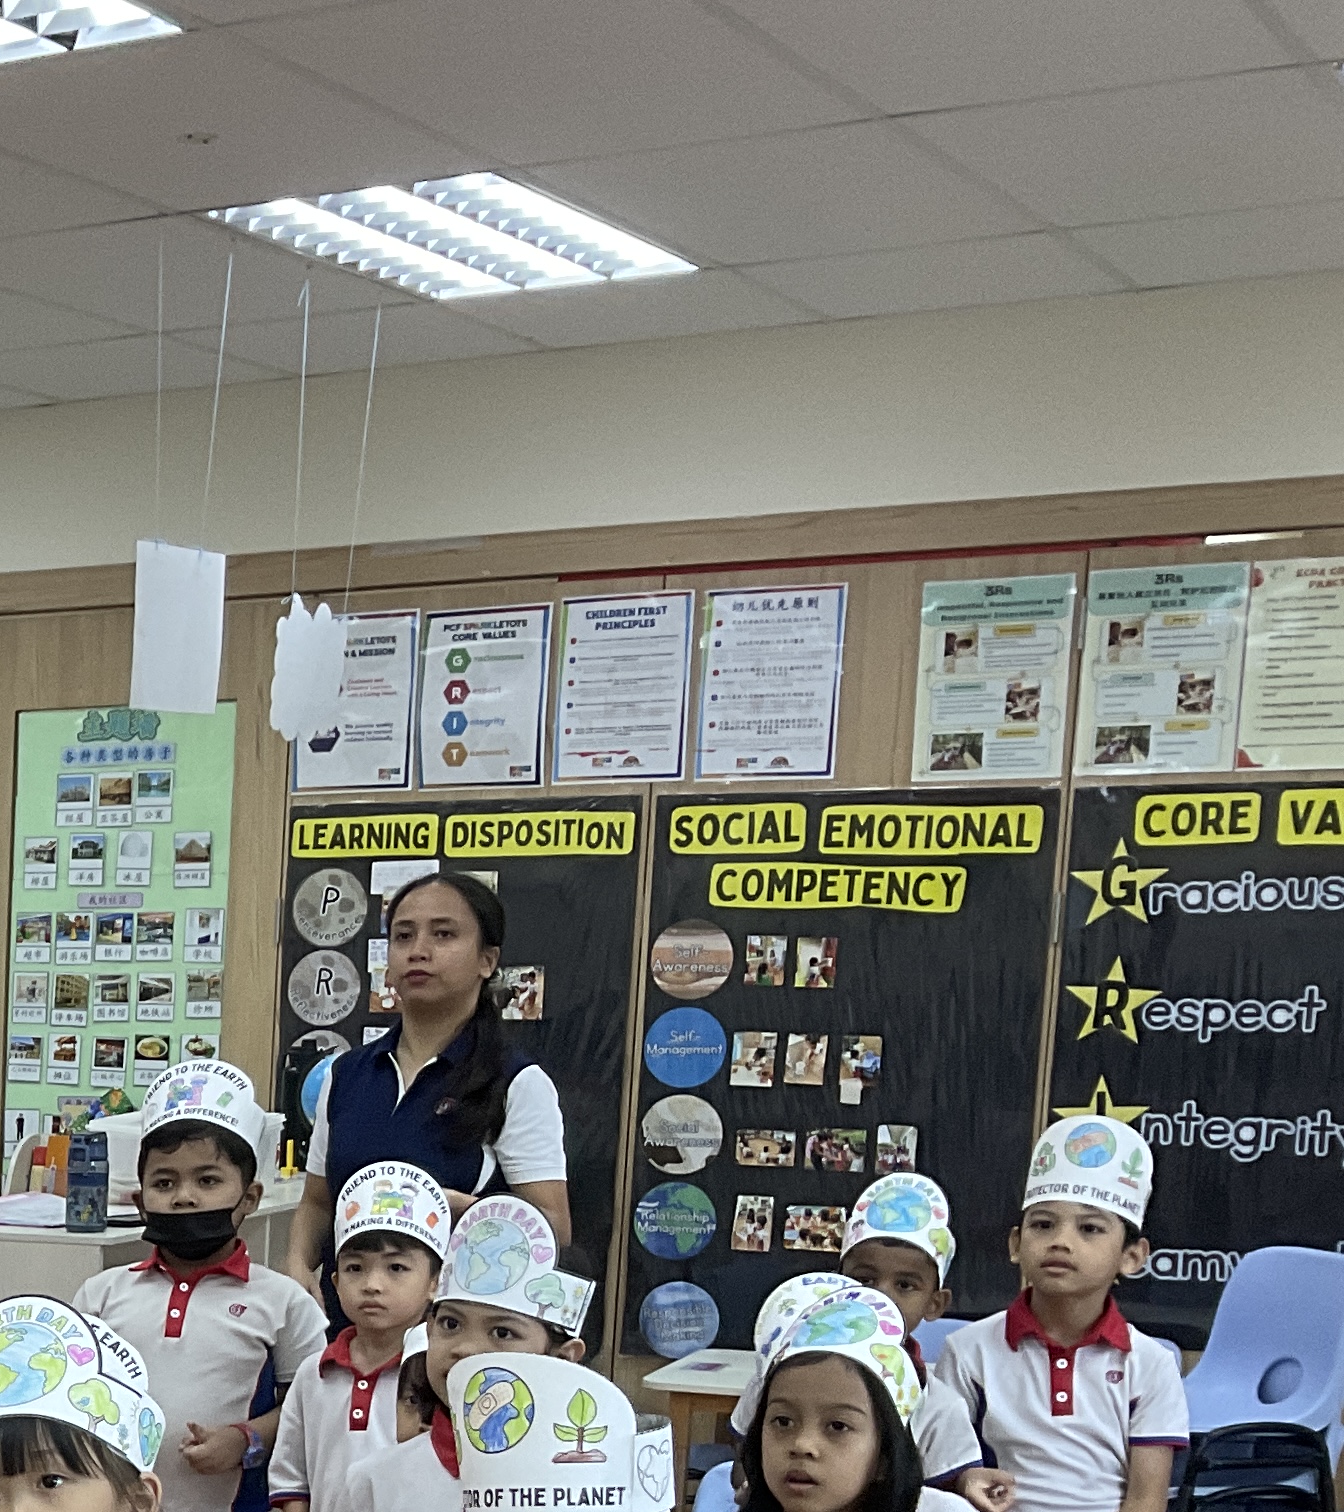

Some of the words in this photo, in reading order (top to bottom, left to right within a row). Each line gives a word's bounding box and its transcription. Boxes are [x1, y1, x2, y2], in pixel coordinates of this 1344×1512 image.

[586, 607, 635, 619] CHILDREN
[638, 605, 667, 617] FIRST
[595, 618, 656, 631] PRINCIPLES
[452, 632, 478, 642] CORE
[482, 630, 516, 640] VALUES
[673, 809, 800, 848] SOCIAL
[823, 812, 1034, 850] EMOTIONAL
[1143, 799, 1252, 838] CORE
[298, 822, 431, 850] LEARNING
[451, 819, 626, 850] DISPOSITION
[715, 868, 963, 907] COMPETENCY
[320, 886, 340, 917] P
[652, 959, 729, 974] Awareness
[315, 967, 333, 997] R
[646, 1043, 723, 1057] Management
[174, 1065, 191, 1077] TO
[192, 1063, 211, 1075] THE
[213, 1065, 248, 1091] EARTH
[659, 1119, 700, 1135] Social
[644, 1135, 720, 1149] Awareness
[341, 1170, 376, 1202] FRIEND
[379, 1165, 396, 1176] TO
[399, 1167, 422, 1184] THE
[422, 1181, 448, 1215] EARTH
[1072, 1185, 1088, 1196] OF
[1090, 1186, 1112, 1202] THE
[386, 1218, 393, 1226] A
[460, 1202, 512, 1232] EARTH
[512, 1206, 547, 1240] DAY
[640, 1208, 710, 1224] Relationship
[637, 1221, 715, 1236] Management
[36, 1308, 84, 1341] DAY
[98, 1334, 143, 1381] EARTH
[484, 1488, 504, 1508] OF
[508, 1487, 547, 1508] THE
[552, 1486, 627, 1507] PLANET
